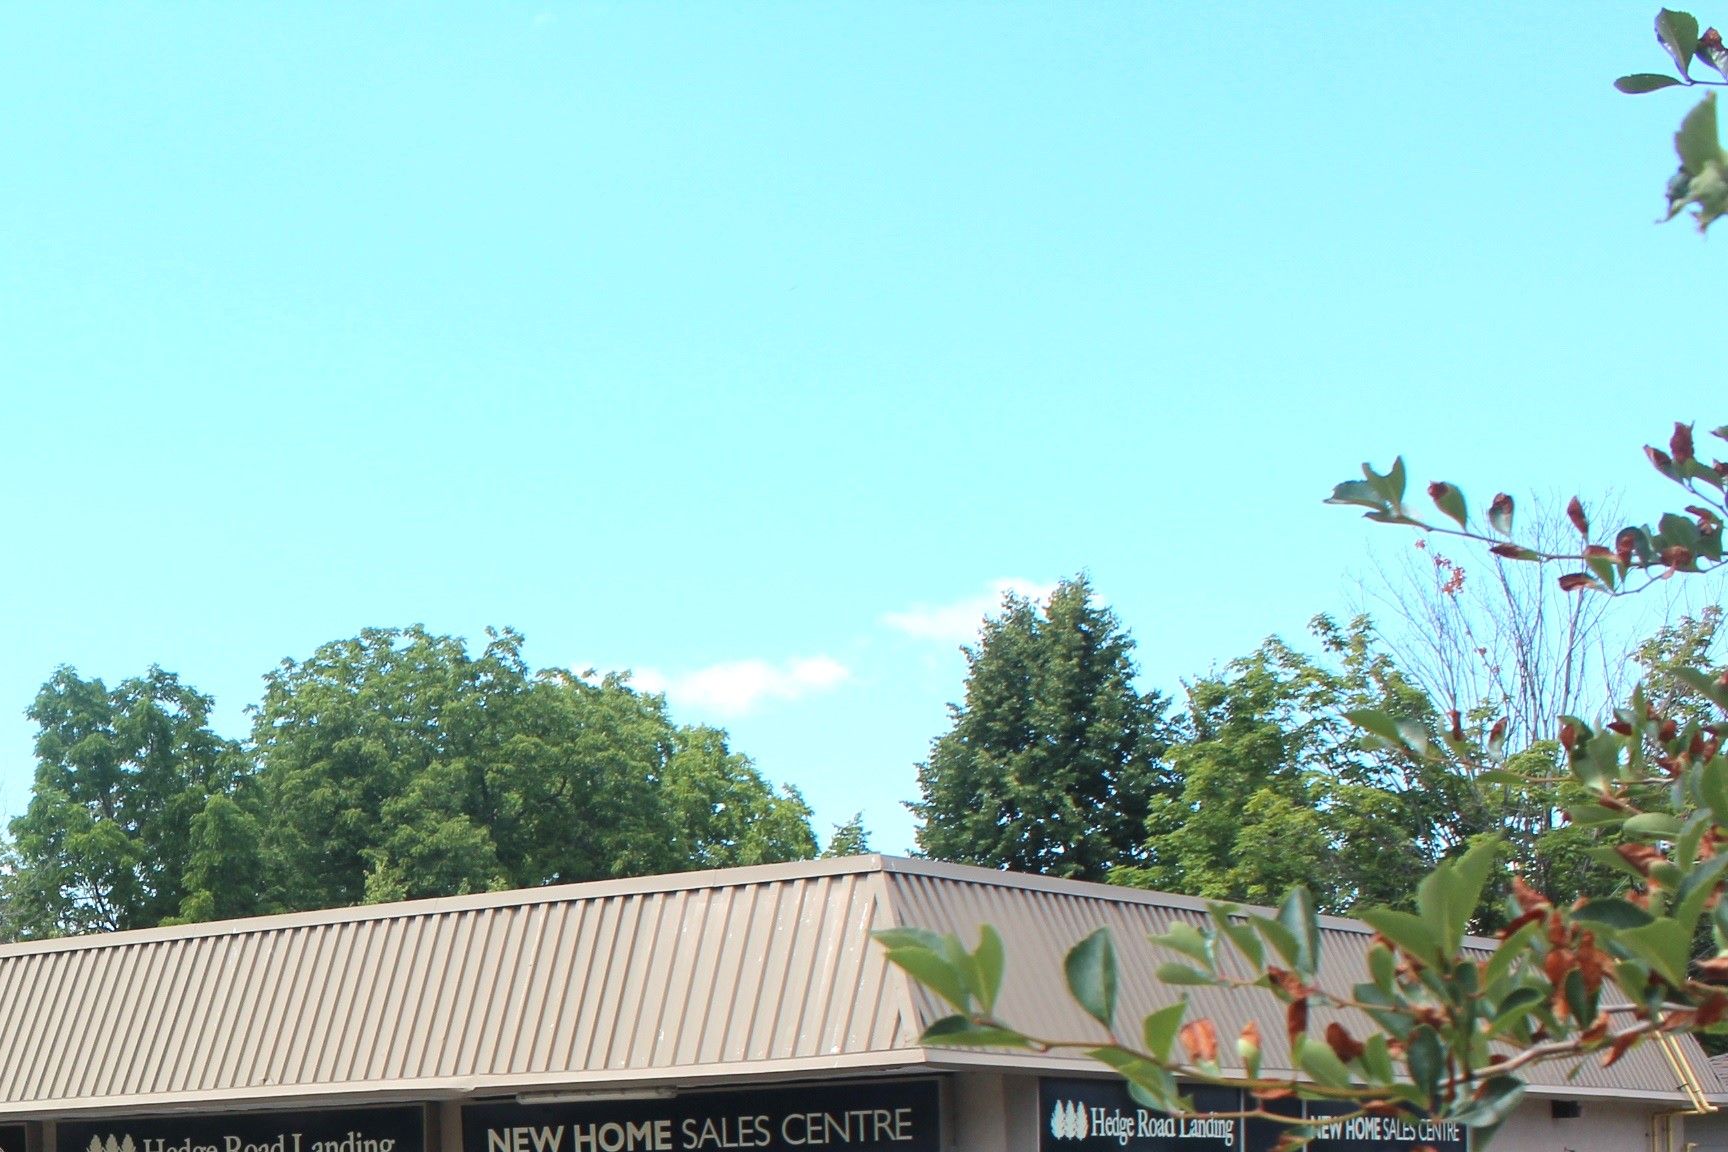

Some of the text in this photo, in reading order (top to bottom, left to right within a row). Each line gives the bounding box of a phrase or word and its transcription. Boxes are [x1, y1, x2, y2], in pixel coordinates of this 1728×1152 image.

[682, 1115, 770, 1149] SALES
[782, 1108, 913, 1146] CENTRE
[1090, 1108, 1234, 1146] Hedge Road Landing
[1346, 1117, 1381, 1140] HOME
[1383, 1118, 1416, 1141] SALES
[1418, 1119, 1460, 1141] CENTRE
